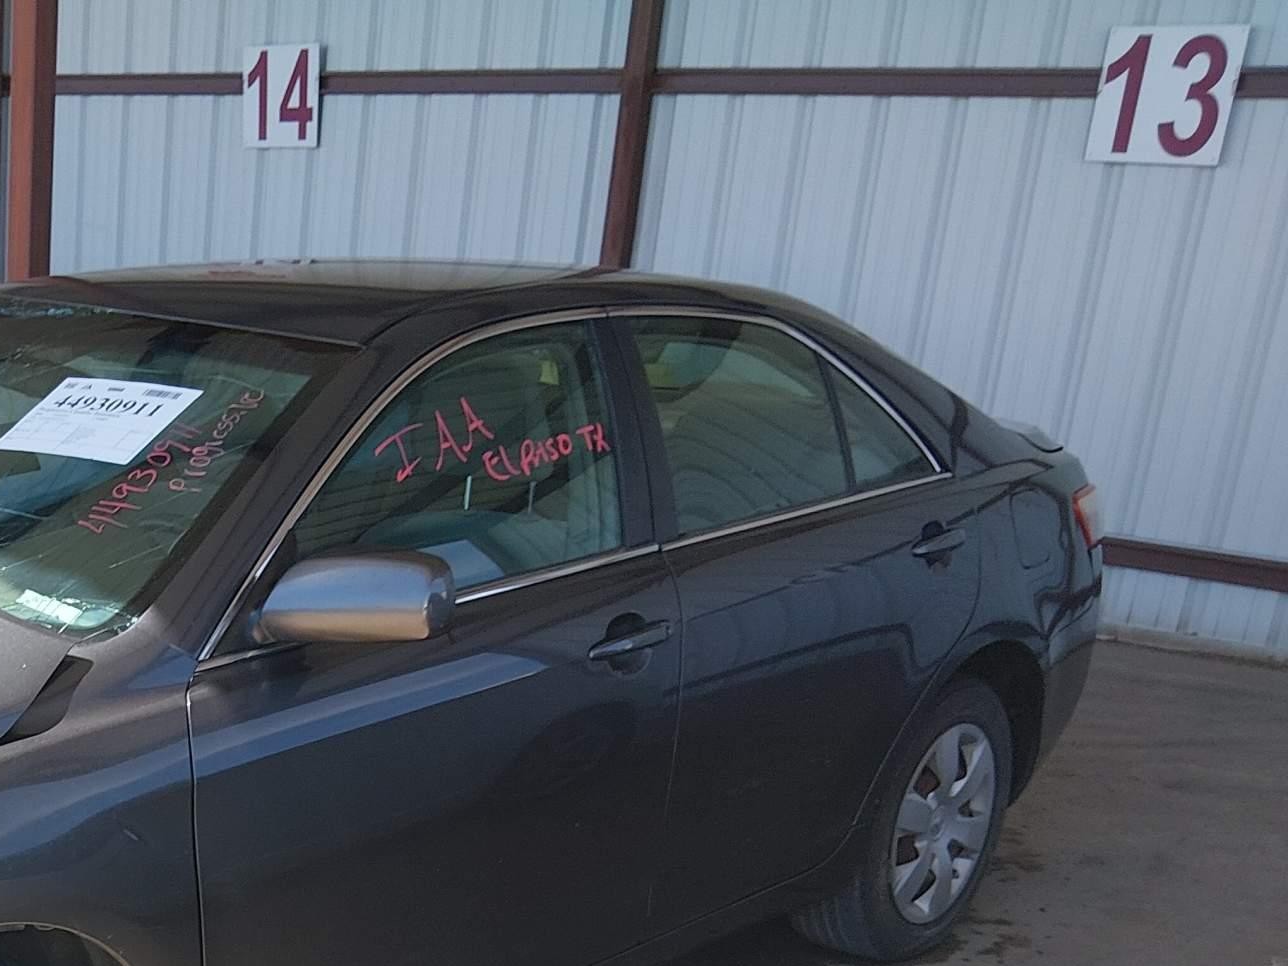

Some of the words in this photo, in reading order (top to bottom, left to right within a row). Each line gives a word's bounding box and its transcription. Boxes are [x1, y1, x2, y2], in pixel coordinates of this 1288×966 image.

[247, 48, 313, 141] 14
[1104, 33, 1228, 158] 13
[54, 394, 164, 417] 44930911
[375, 397, 494, 482] IAA
